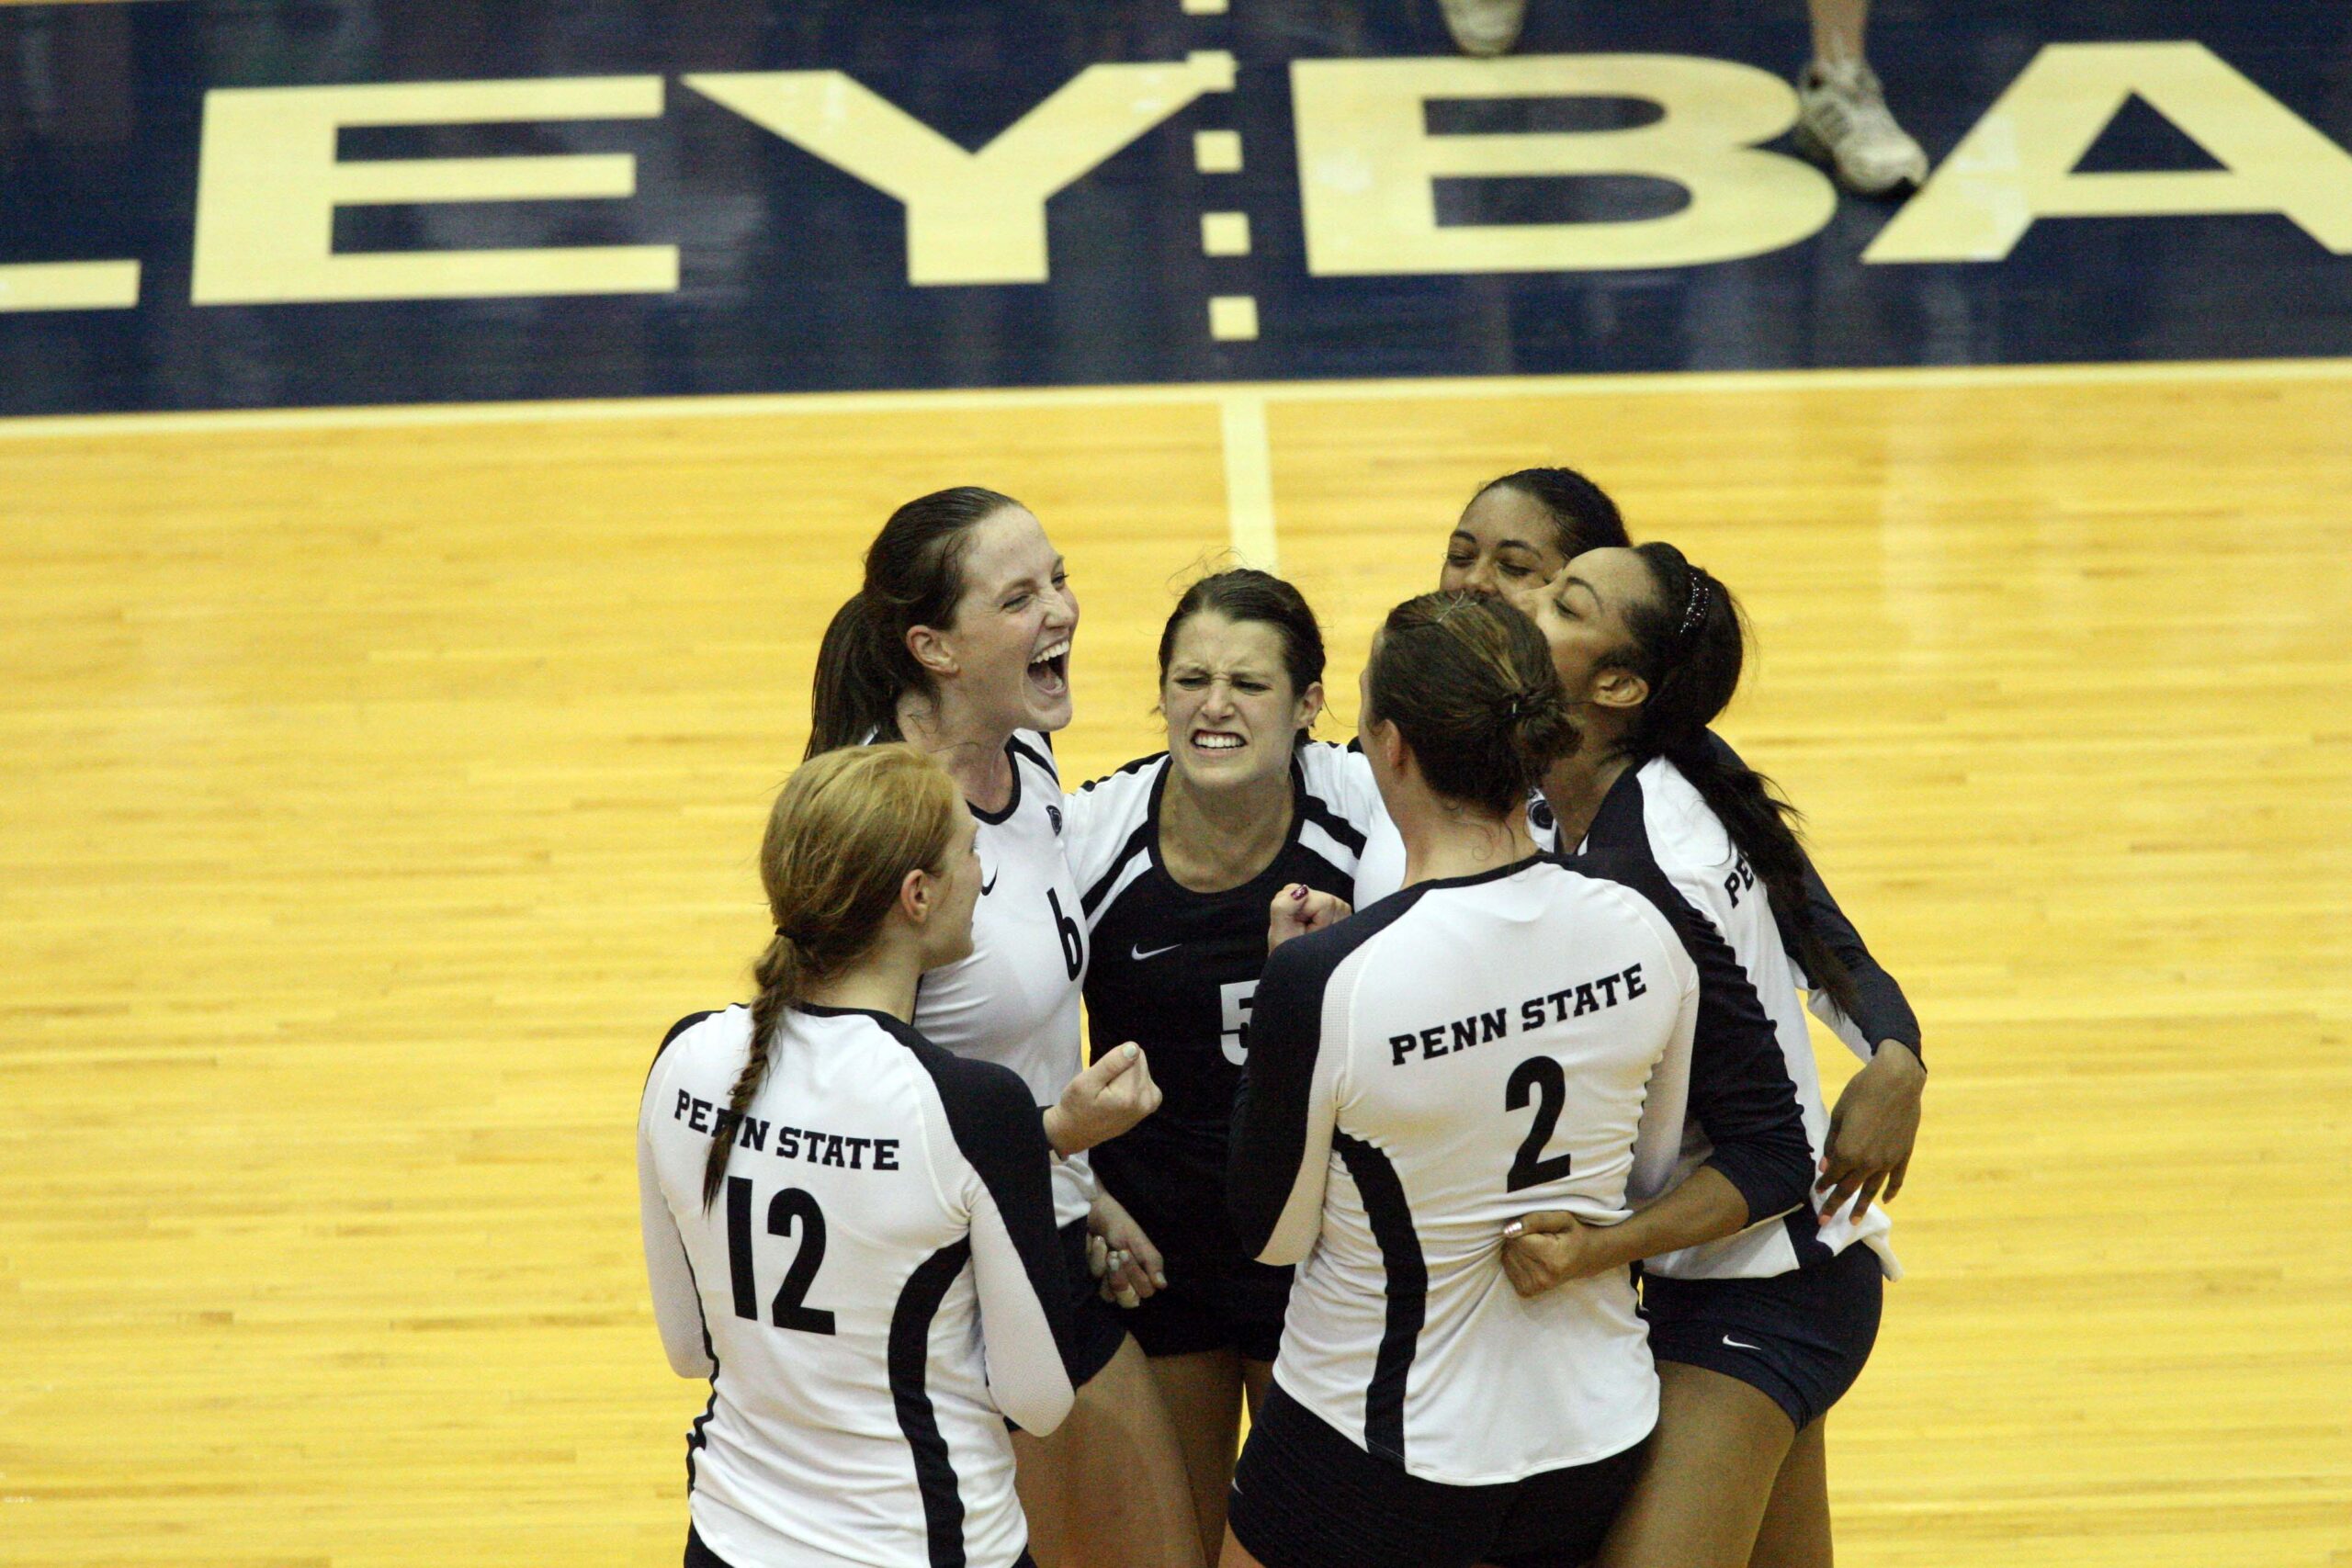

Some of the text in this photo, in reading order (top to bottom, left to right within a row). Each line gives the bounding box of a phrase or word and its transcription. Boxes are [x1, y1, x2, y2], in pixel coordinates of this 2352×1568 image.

[0, 41, 2352, 312] EYBA
[1220, 979, 1261, 1066] 5
[1389, 963, 1647, 1066] PENN STATE
[776, 1126, 899, 1171] STATE
[1505, 1055, 1571, 1194] 2
[727, 1175, 836, 1337] 12
